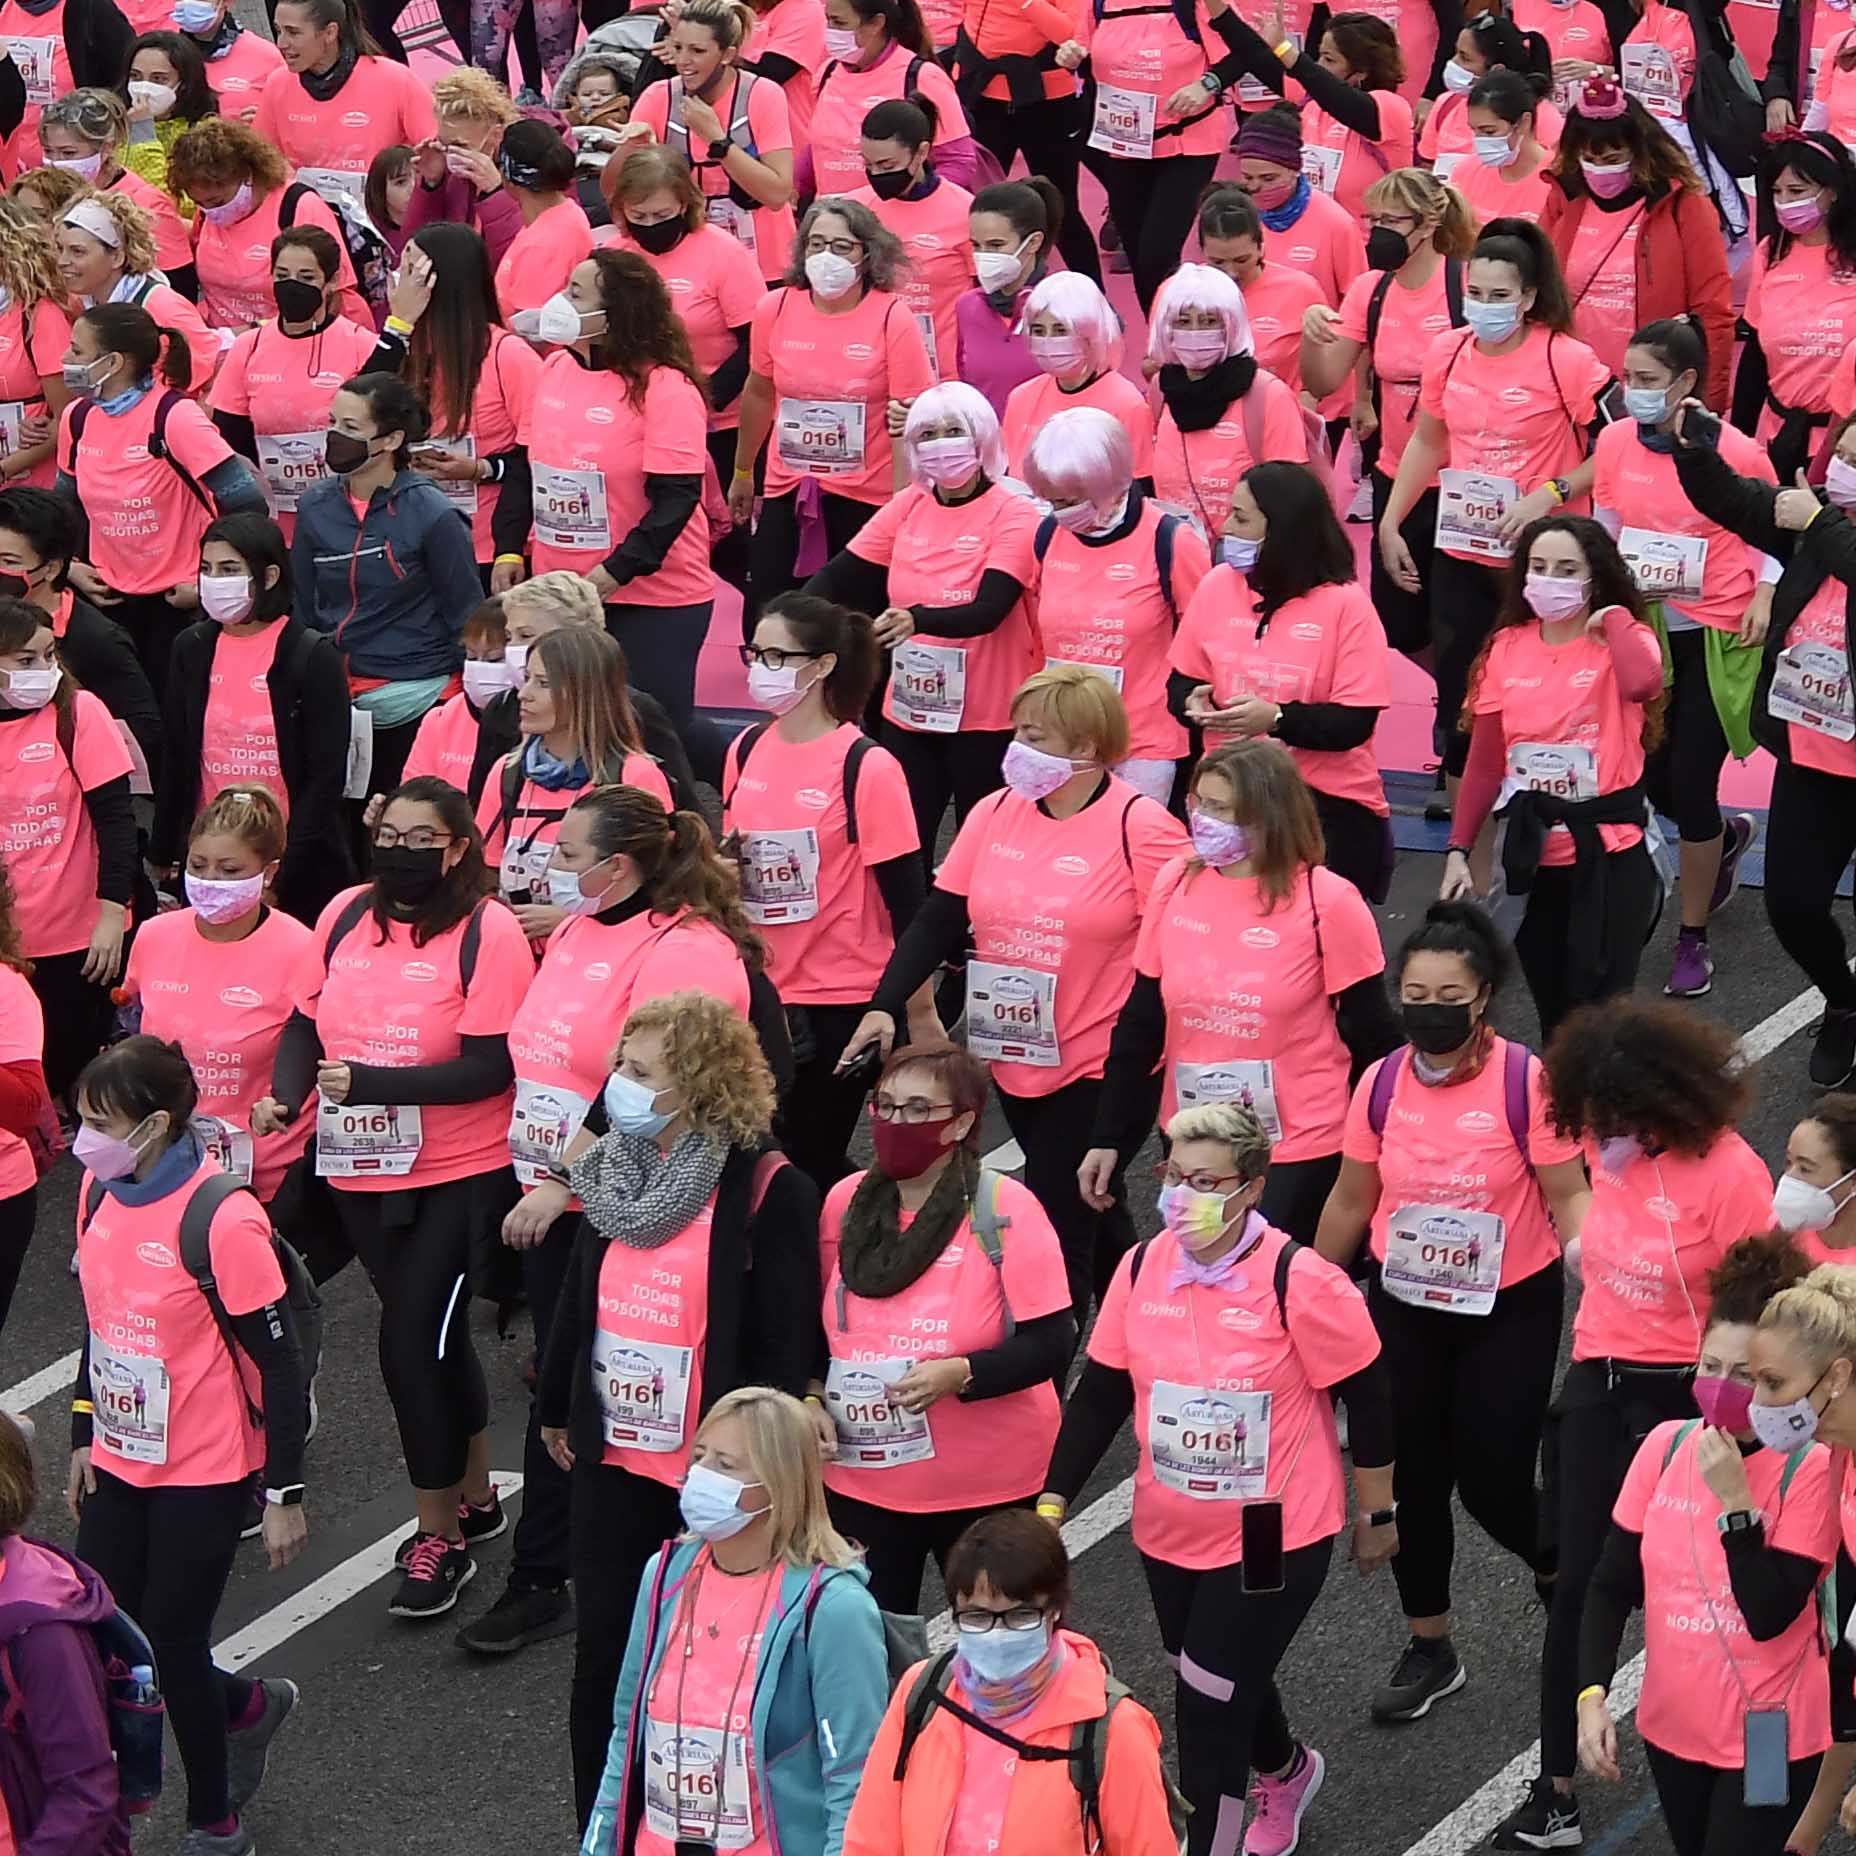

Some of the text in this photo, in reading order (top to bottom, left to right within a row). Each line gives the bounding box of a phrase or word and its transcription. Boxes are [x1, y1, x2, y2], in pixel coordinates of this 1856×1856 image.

[802, 430, 837, 446] 016
[283, 464, 316, 478] 016
[548, 498, 581, 514] 016
[1640, 563, 1675, 582] 016
[1802, 674, 1837, 698] 016
[246, 735, 276, 745] POR
[1033, 915, 1064, 930] POR
[1228, 991, 1262, 1006] POR
[994, 1003, 1033, 1022] 016
[385, 1025, 419, 1040] POR
[206, 1052, 241, 1064] POR
[344, 1115, 386, 1133] 016
[527, 1123, 555, 1146] 016
[1421, 1244, 1467, 1267] 016
[651, 1269, 682, 1288] POR
[127, 1310, 156, 1329] POR
[911, 1318, 949, 1333] POR
[888, 1334, 946, 1353] TODAS
[100, 1383, 132, 1414] 016
[609, 1379, 650, 1404] 016
[846, 1404, 888, 1423] 016
[1182, 1430, 1233, 1451] 016
[667, 1770, 714, 1795] 016
